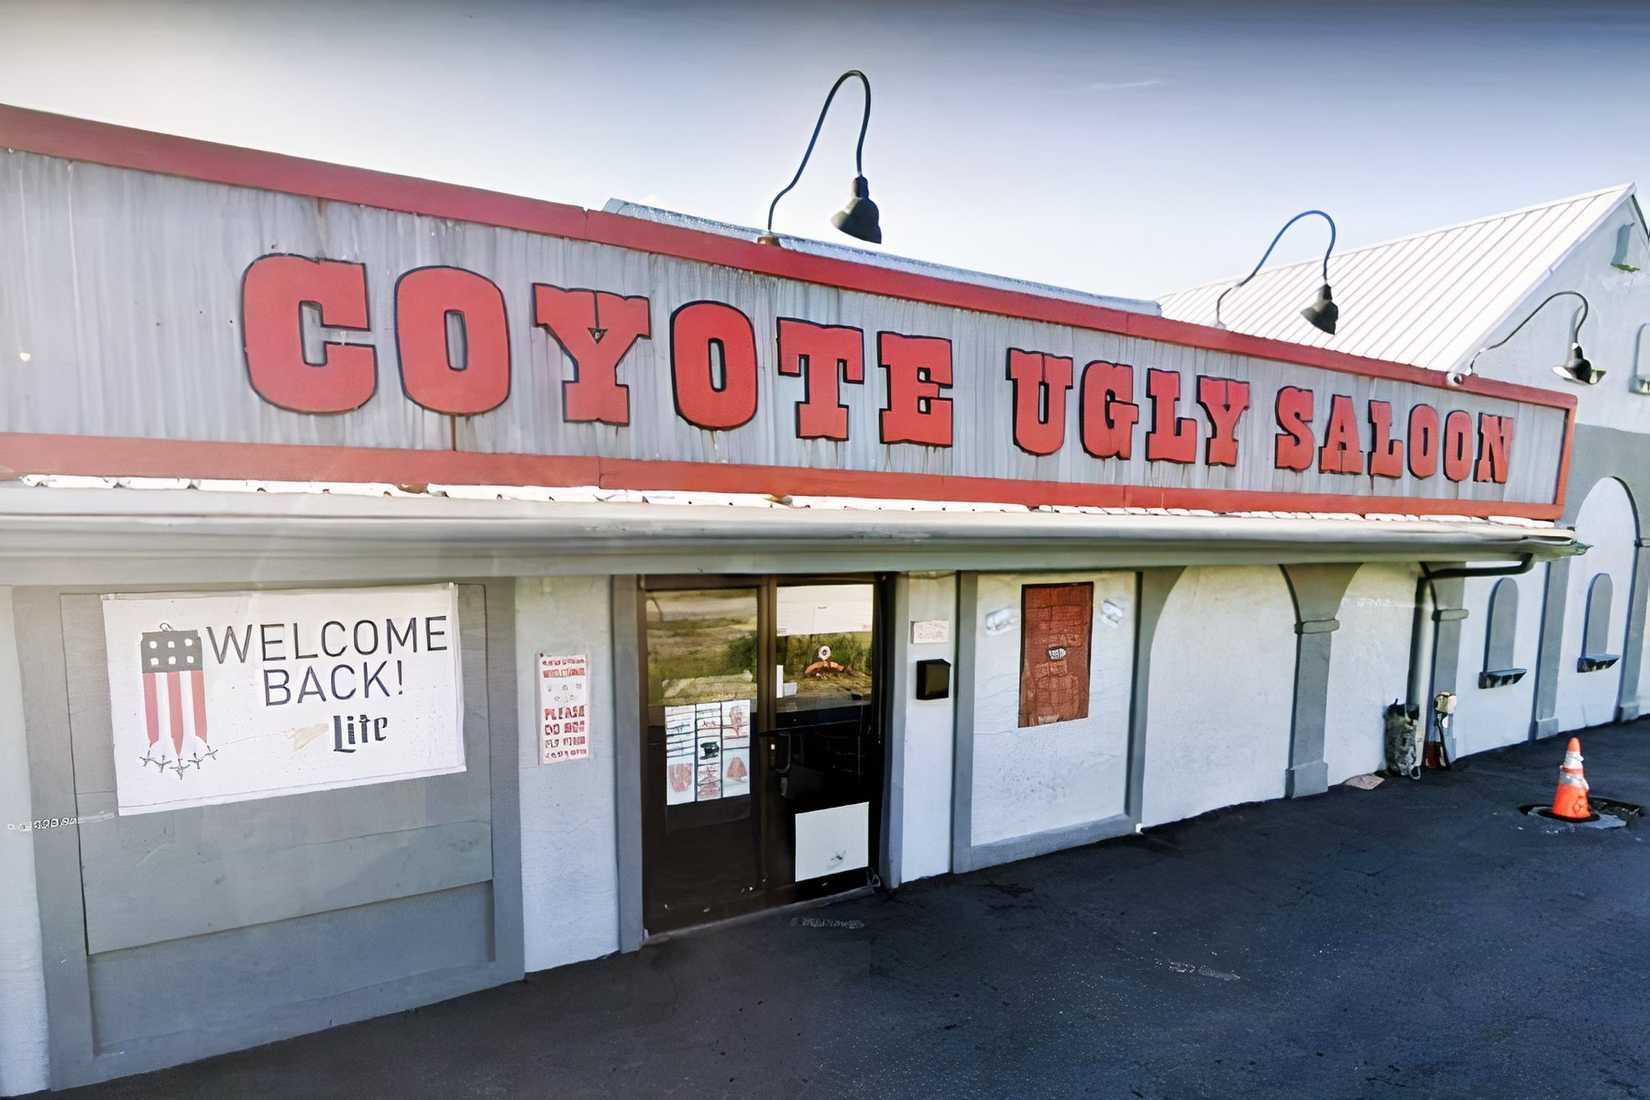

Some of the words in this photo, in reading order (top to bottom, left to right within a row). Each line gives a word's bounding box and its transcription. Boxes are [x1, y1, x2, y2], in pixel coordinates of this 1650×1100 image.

[242, 252, 954, 447] COYOTE
[1005, 347, 1250, 467] UGLY
[1274, 386, 1514, 484] SALOON
[206, 616, 447, 664] WELCOME
[263, 660, 403, 706] BACK!
[333, 714, 388, 753] Lite
